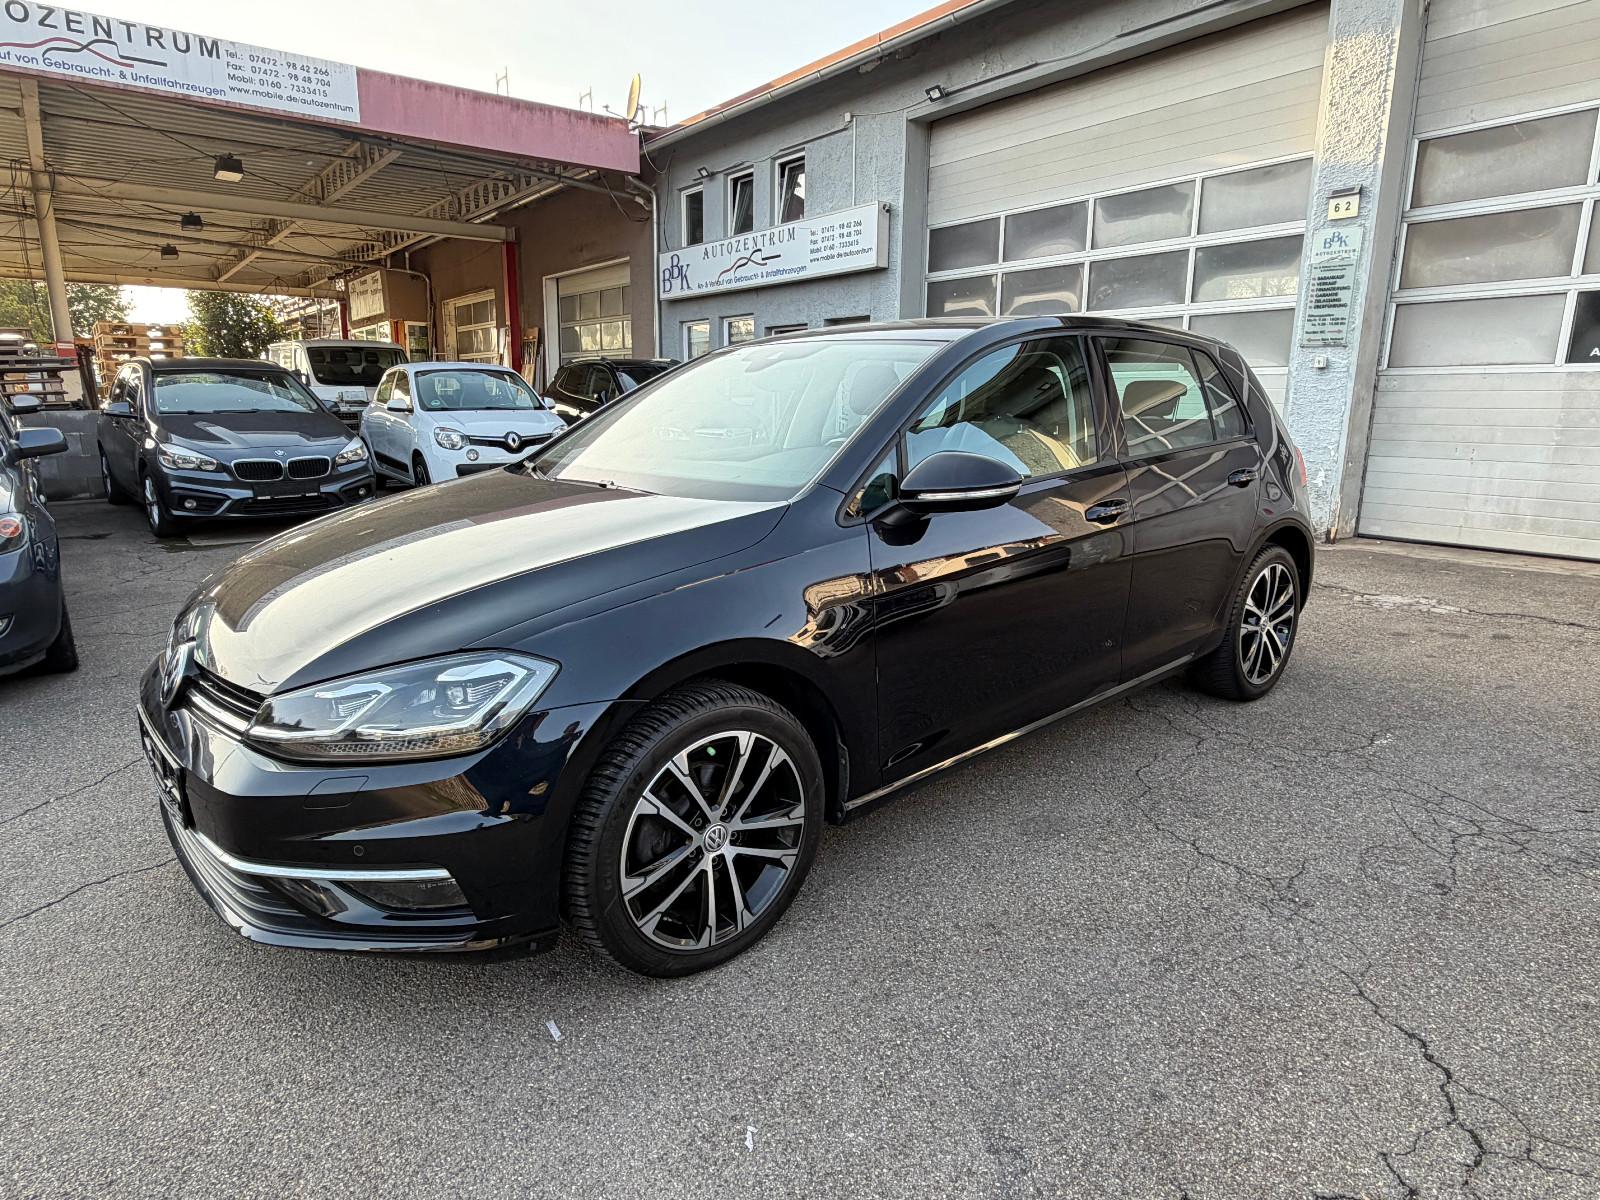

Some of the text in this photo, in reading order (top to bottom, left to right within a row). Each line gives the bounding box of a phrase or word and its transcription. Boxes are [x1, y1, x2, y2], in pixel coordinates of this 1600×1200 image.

[5, 0, 221, 60] OZENTRUM
[15, 54, 39, 65] von
[42, 57, 116, 78] Gebraucht-
[119, 70, 128, 80] &
[130, 71, 227, 97] Unfallfahrzeugen
[226, 61, 246, 72] Fax:
[250, 65, 280, 79] 07472
[287, 72, 299, 82] 98
[302, 75, 313, 84] 48
[315, 78, 332, 88] 704
[249, 54, 278, 67] 07472
[286, 61, 297, 71] 98
[300, 64, 311, 74] 42
[313, 67, 330, 77] 266
[227, 73, 257, 86] Mobil:
[258, 78, 282, 90] 0160
[290, 83, 328, 98] 7333415
[228, 85, 354, 113] www.mobile.de/autozentrum
[702, 226, 796, 260] AUTOZENTRUM
[1323, 231, 1349, 249] BBK
[662, 253, 693, 294] BBK
